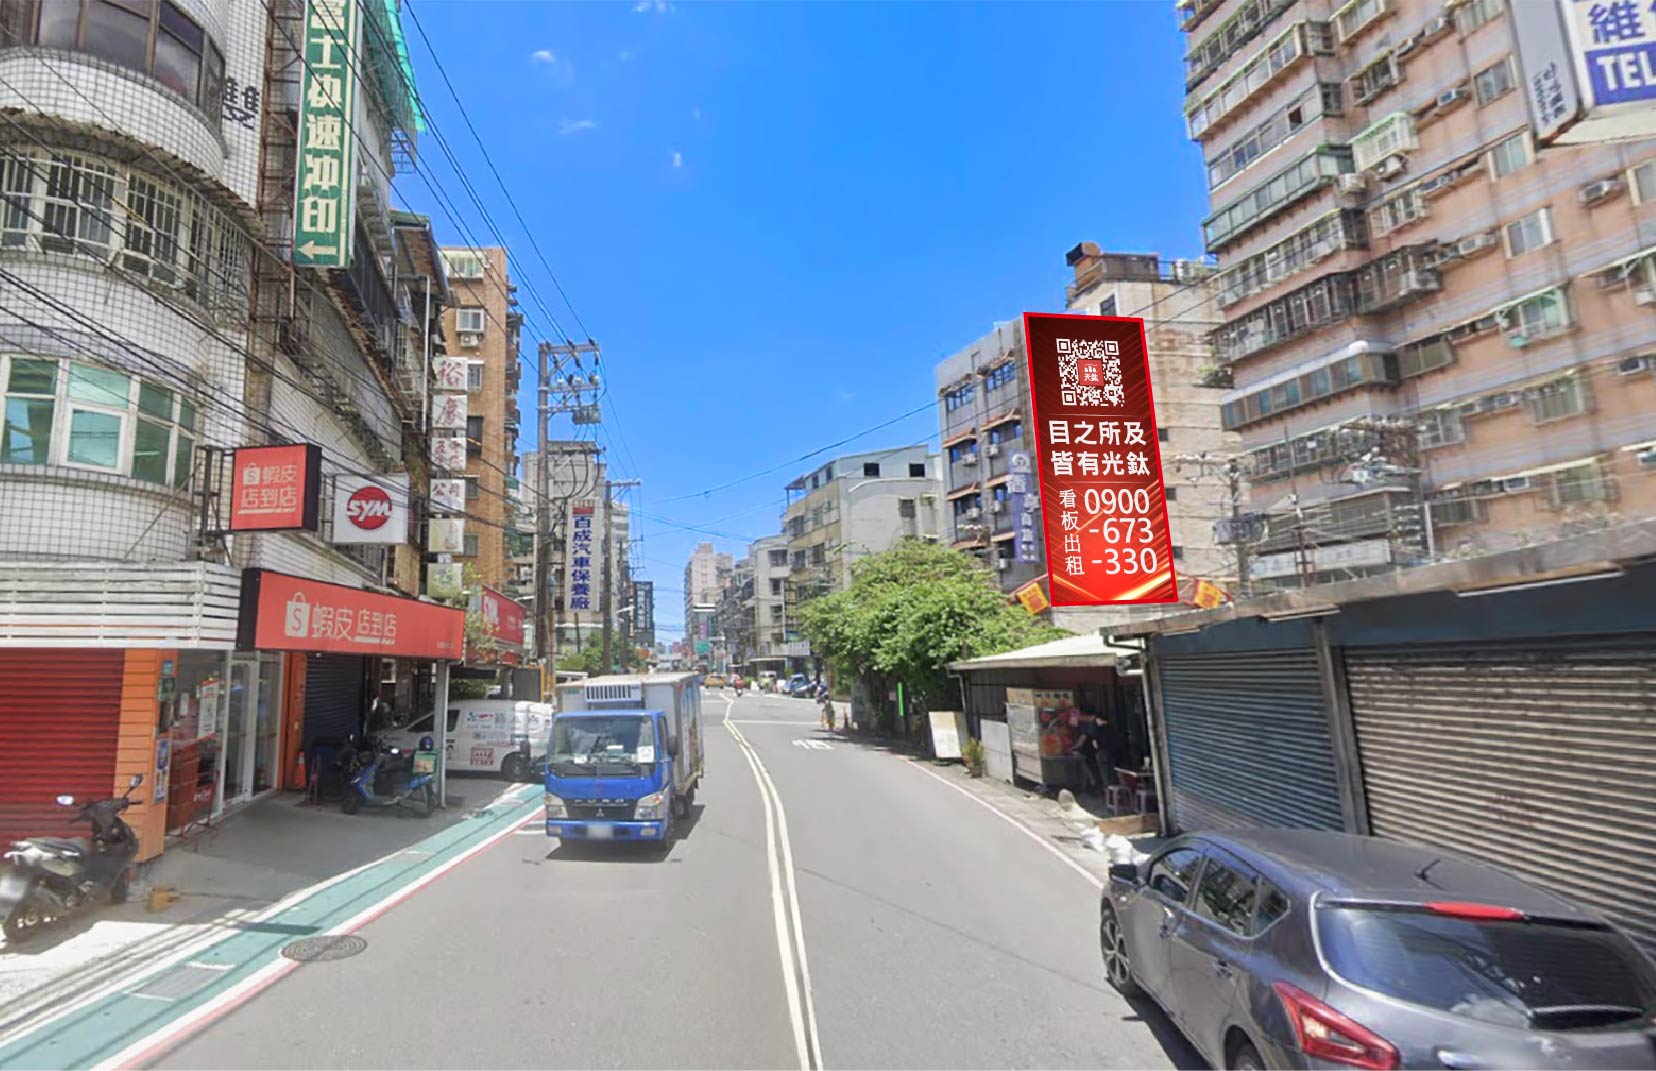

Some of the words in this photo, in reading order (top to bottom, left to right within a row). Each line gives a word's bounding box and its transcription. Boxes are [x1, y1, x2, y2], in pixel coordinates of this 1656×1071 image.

[1588, 1, 1656, 44] 維
[1596, 50, 1656, 91] TEL
[1049, 420, 1147, 446] 目之所及
[262, 464, 297, 485] 蝦皮
[1051, 450, 1150, 476] 皆有光鈦
[241, 487, 297, 508] 店到店
[346, 499, 392, 522] SYM
[1084, 489, 1150, 515] 0900
[1059, 489, 1085, 576] 看板出租
[1089, 517, 1154, 544] -673
[1092, 548, 1158, 575] -330
[312, 602, 353, 641] 蝦皮
[357, 609, 397, 637] 店到店
